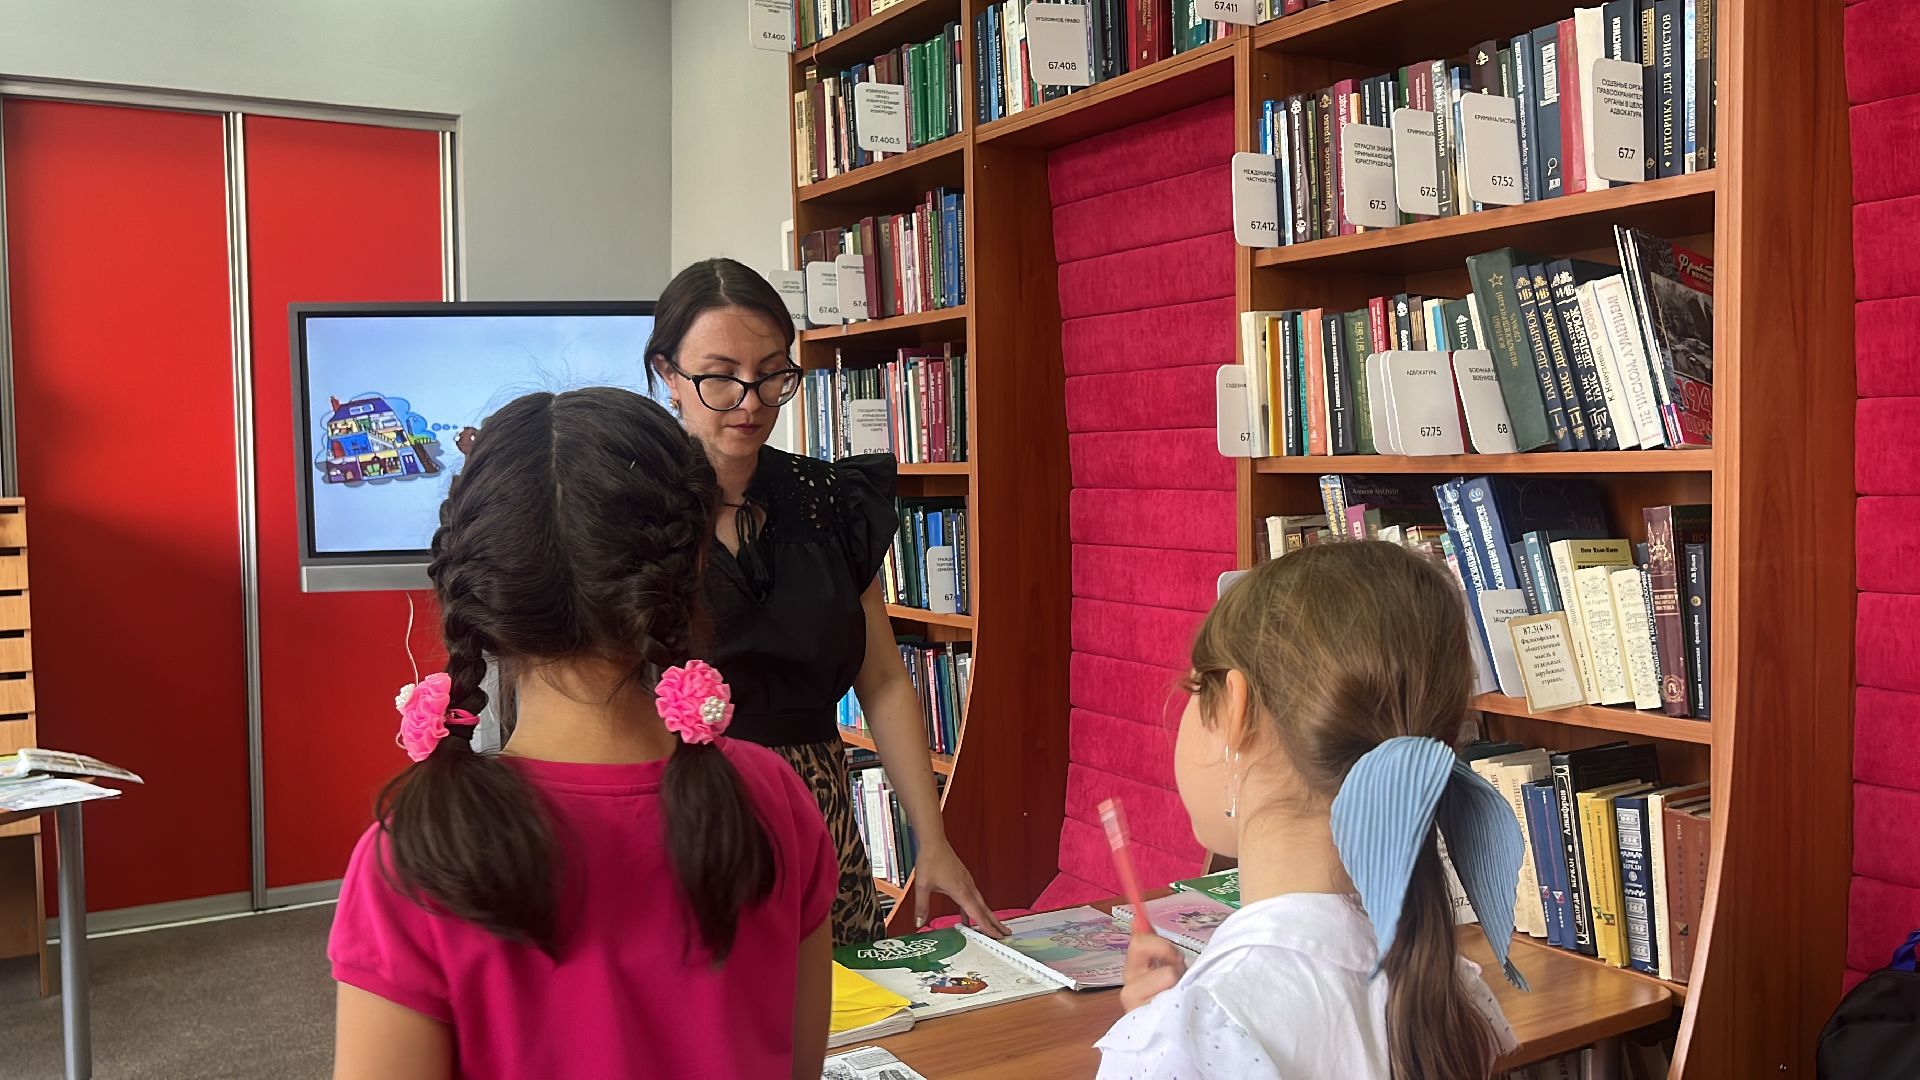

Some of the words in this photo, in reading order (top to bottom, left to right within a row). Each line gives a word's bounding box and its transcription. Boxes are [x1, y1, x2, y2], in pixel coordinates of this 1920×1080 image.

[1214, 1, 1238, 13] 67.411
[762, 31, 786, 41] 67.400
[1662, 13, 1672, 68] ЮРИСТОВ
[1048, 61, 1077, 70] 67.408
[1601, 78, 1628, 89] СУДЕБНЫЕ
[1663, 72, 1673, 94] ДЛЯ
[1603, 97, 1625, 107] ОРГАНЫ
[1609, 108, 1642, 118] АДВОКАТУРА
[1663, 99, 1673, 156] РИТОРИКА
[870, 135, 901, 145] 67.400.5
[1618, 147, 1636, 160] 67.7
[1246, 176, 1268, 184] ЧАСТНОЕ
[1323, 147, 1332, 212] Европейское
[1491, 175, 1514, 187] 67.52
[1369, 199, 1387, 210] 67.5
[819, 306, 840, 314] 67.40
[1581, 298, 1597, 331] ВОЙНЕ
[1510, 312, 1522, 343] СЛОВАРЬ
[1606, 294, 1632, 349] УМЕНЬЕМ!
[1525, 308, 1549, 369] ДЕЛЬБРЮК
[1543, 308, 1568, 369] ДЕЛЬБРЮК
[1569, 305, 1594, 368] ДЕЛЬБРЮК
[1590, 331, 1600, 341] О
[1622, 348, 1634, 358] А
[1595, 345, 1613, 393] Клаузевиц
[1541, 371, 1556, 400] ГАНС
[1559, 371, 1574, 400] ГАНС
[1588, 371, 1602, 402] ГАНС
[1626, 358, 1648, 410] ЧИСЛОМ,
[1639, 408, 1653, 427] НЕ
[1420, 426, 1442, 437] 67.75
[1497, 423, 1508, 434] 68
[1476, 504, 1495, 550] НОВЕЙШАЯ
[1533, 659, 1562, 669] отдельных
[1535, 666, 1565, 678] зарубежных
[1639, 660, 1647, 670] 2
[1559, 789, 1572, 836] Алкифрон
[1572, 892, 1584, 927] ДЖОРДЖ
